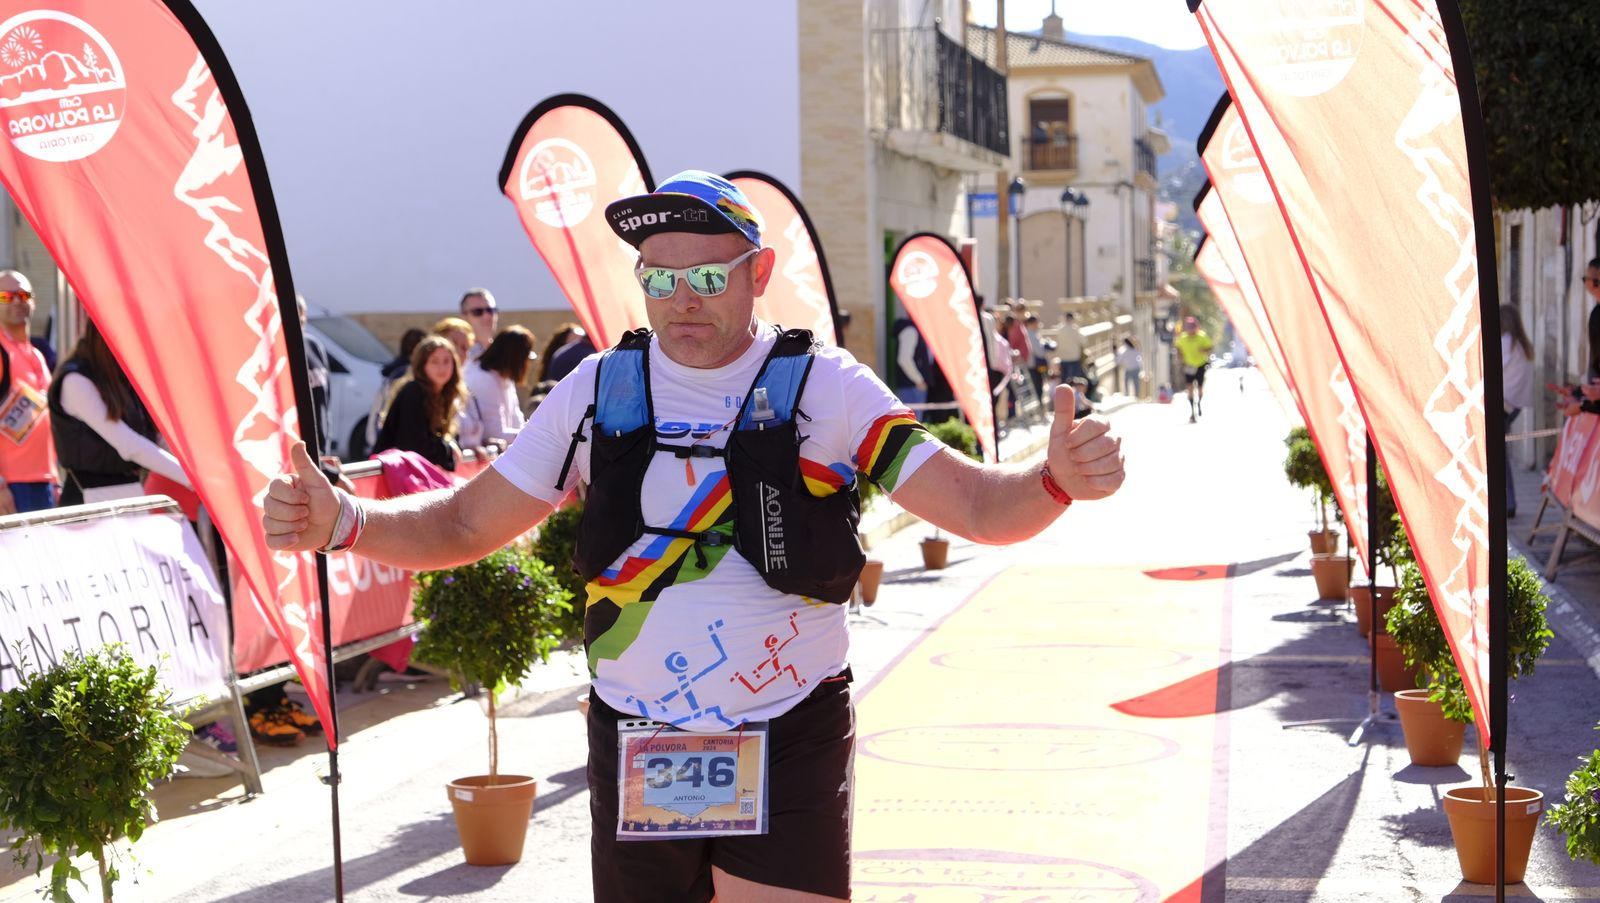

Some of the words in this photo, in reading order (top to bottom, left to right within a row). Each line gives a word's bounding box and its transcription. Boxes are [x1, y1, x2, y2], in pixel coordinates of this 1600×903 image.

[612, 208, 633, 220] CLUB
[765, 485, 788, 569] AONIJIE
[646, 756, 735, 789] 346
